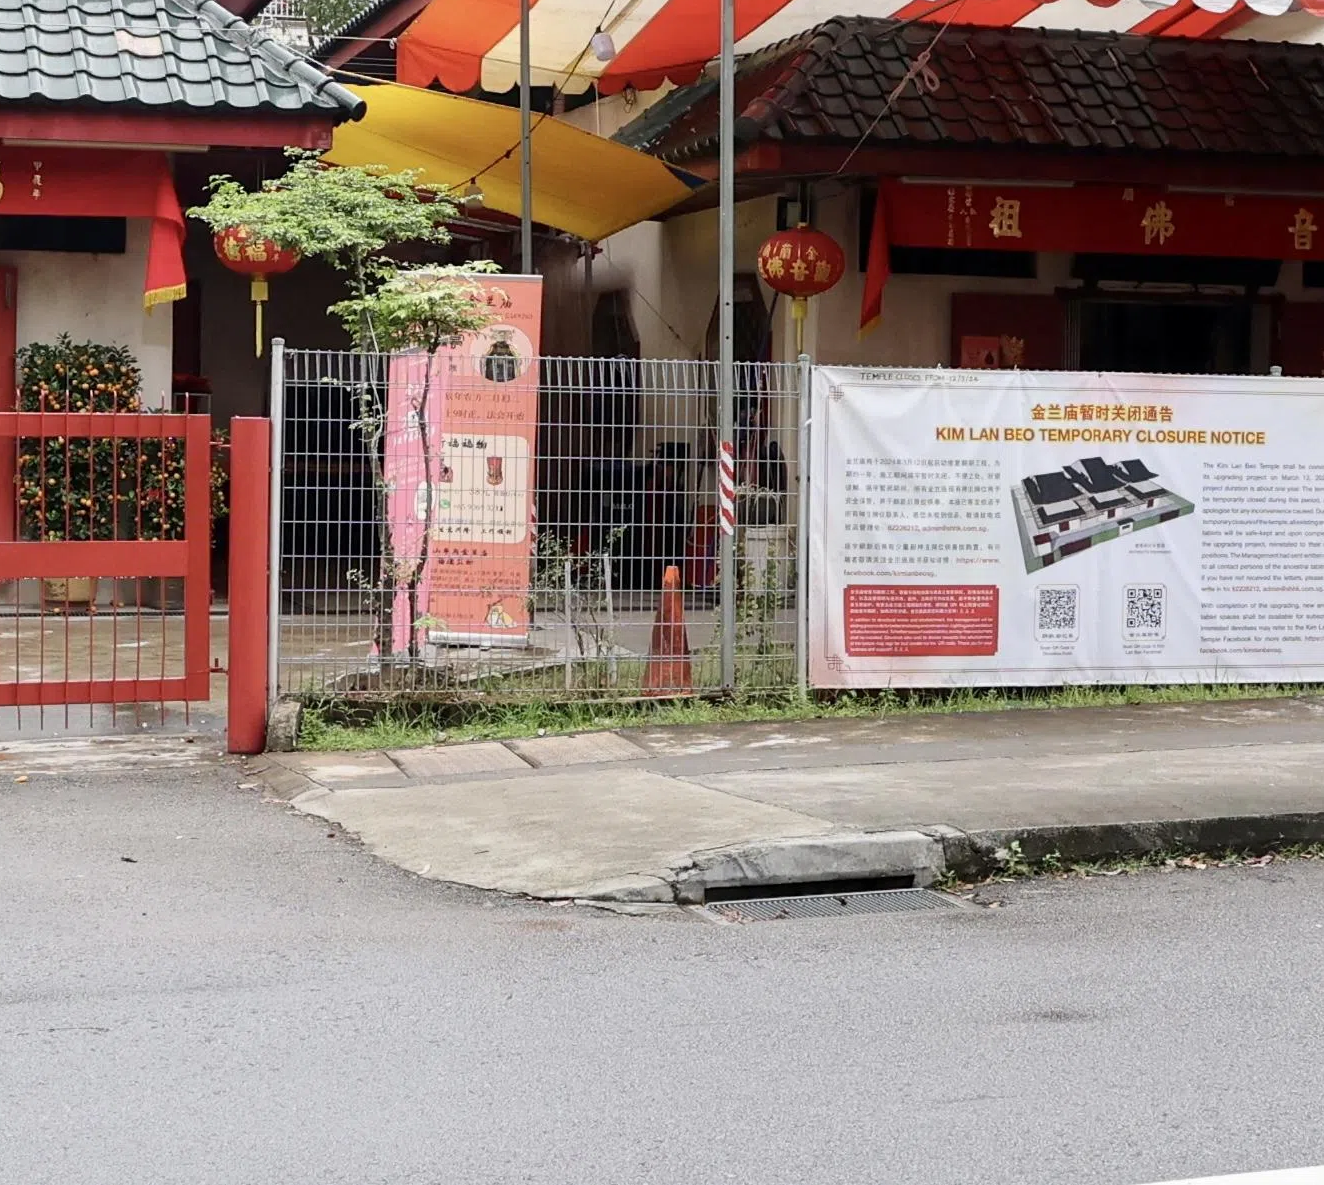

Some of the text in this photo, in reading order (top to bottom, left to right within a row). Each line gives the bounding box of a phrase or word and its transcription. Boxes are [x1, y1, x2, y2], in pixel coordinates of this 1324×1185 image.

[860, 372, 893, 381] TEMPLE
[1031, 403, 1174, 423] 金兰庙暂时关闭通告
[936, 427, 1265, 445] KIM LAN BEO TEMPORARY CLOSURE NOTICE
